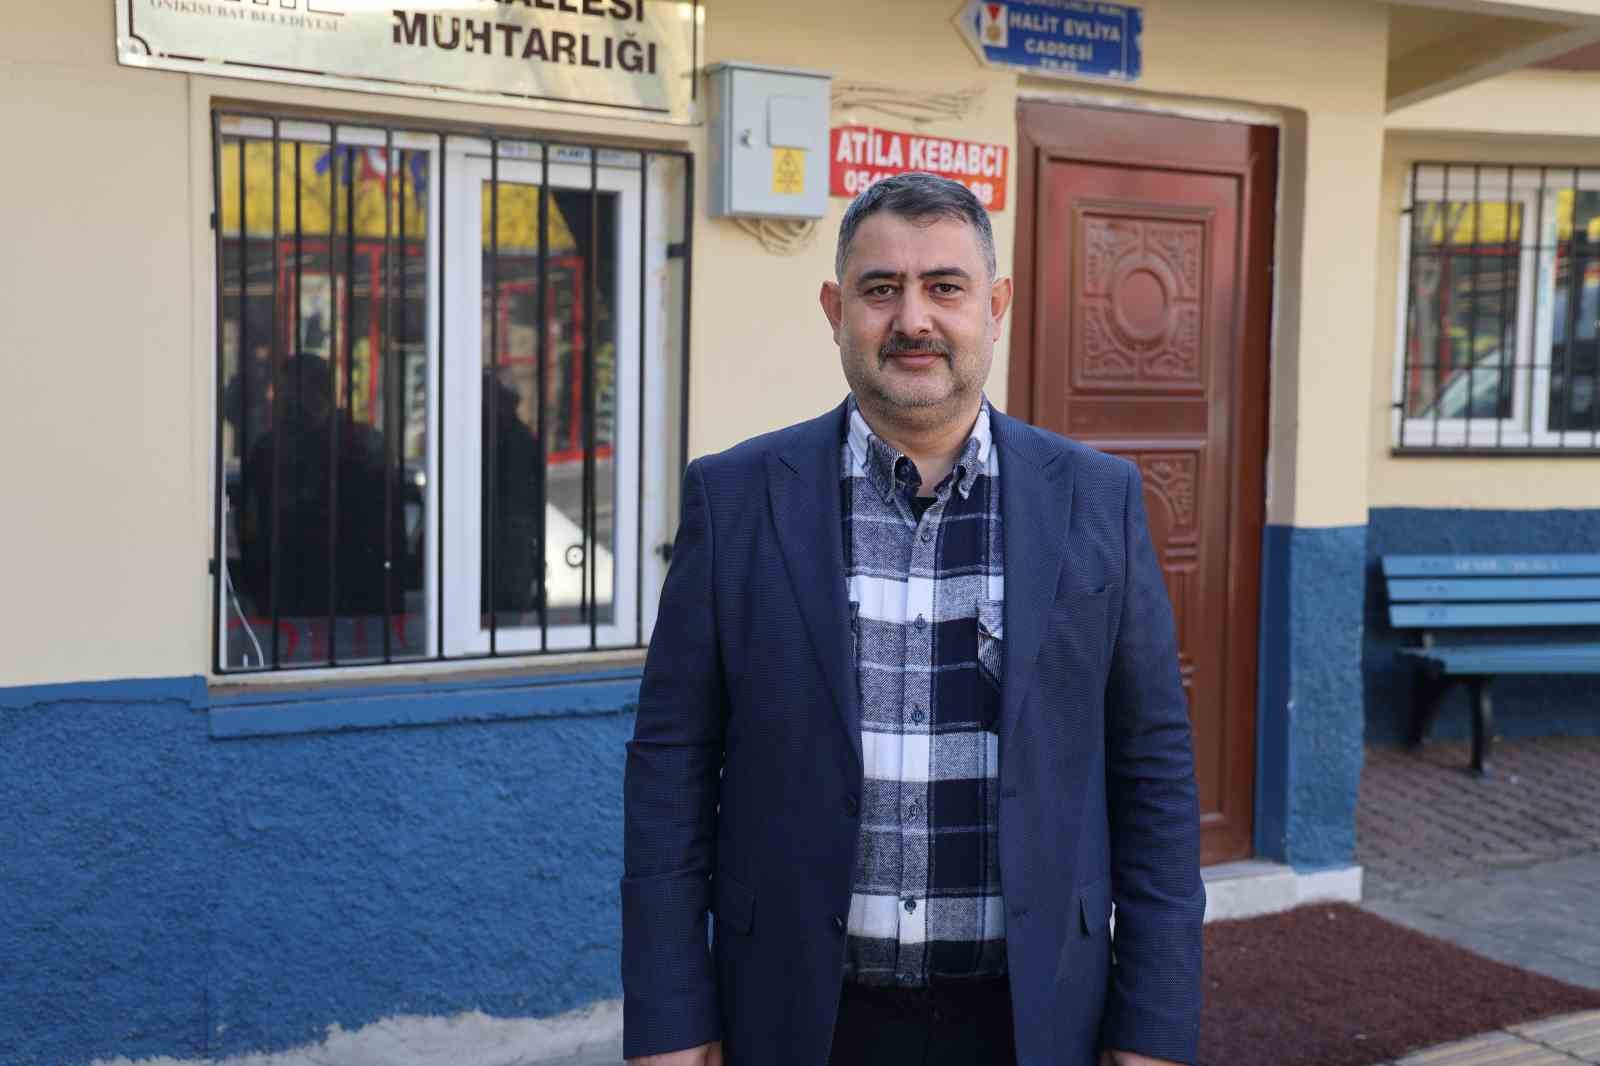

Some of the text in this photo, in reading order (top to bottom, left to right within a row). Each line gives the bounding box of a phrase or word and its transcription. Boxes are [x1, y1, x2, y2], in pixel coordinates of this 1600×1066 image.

[393, 10, 656, 74] MUHTARLIĞI
[1009, 11, 1120, 42] HALİT EVLİYA
[836, 128, 1003, 177] ATİLA KEBABCI
